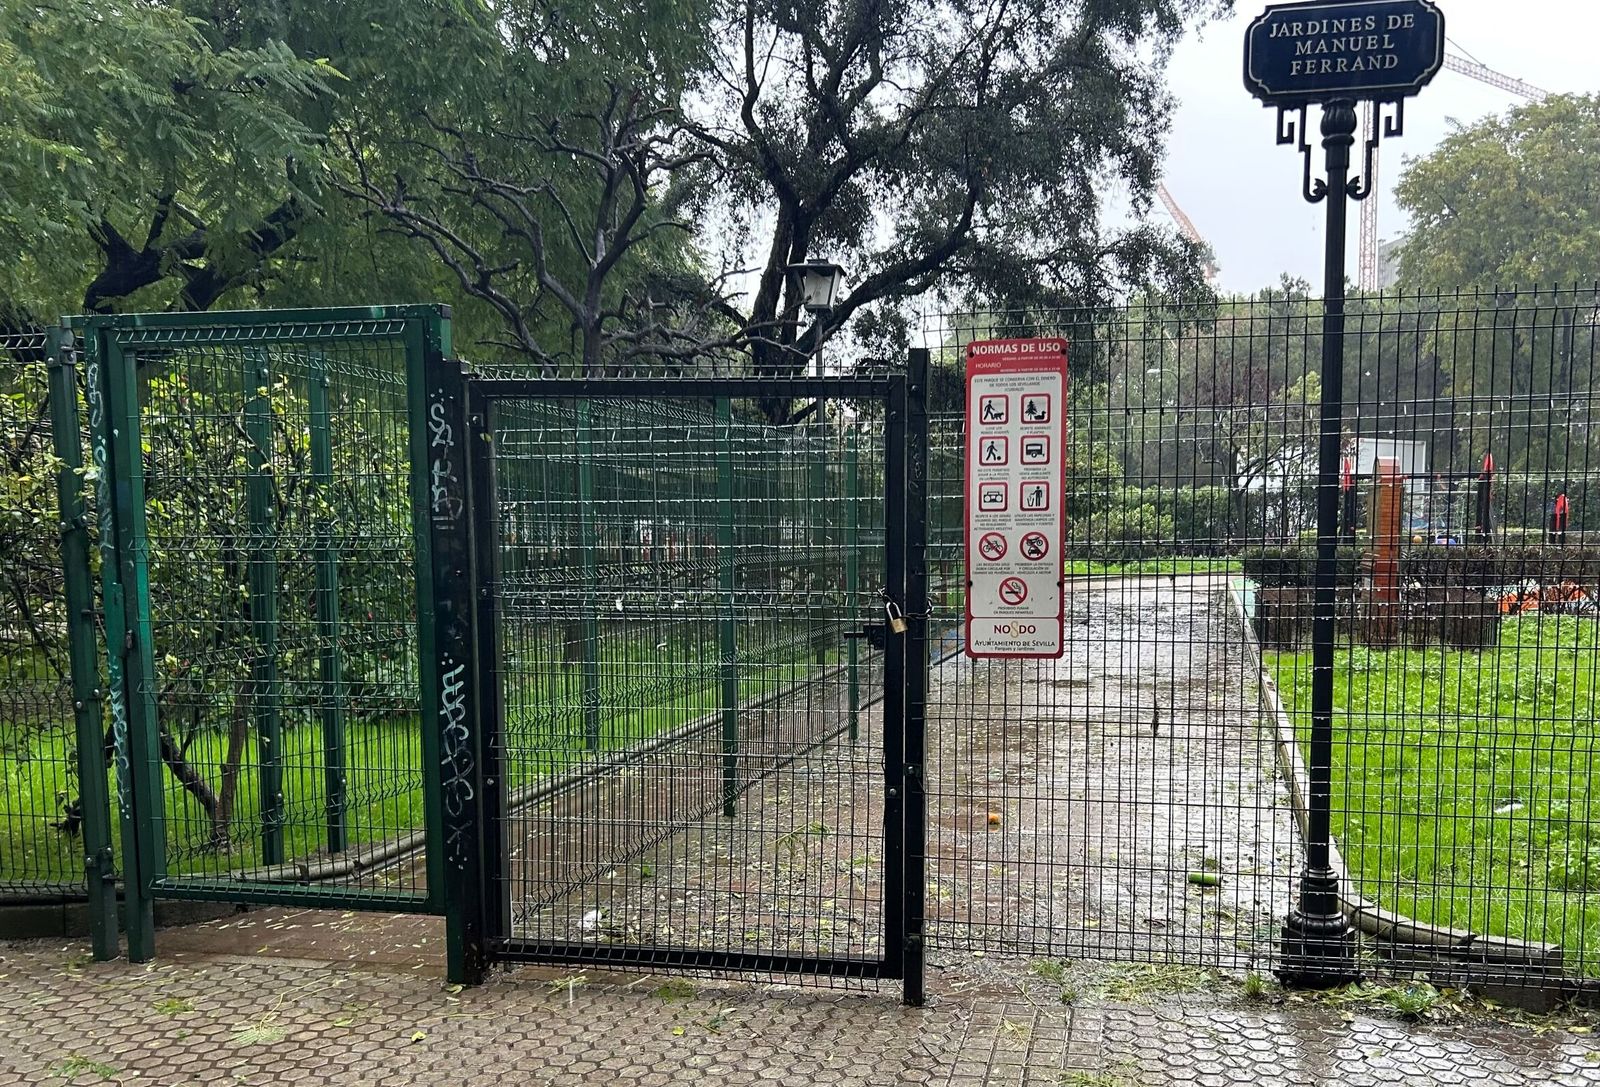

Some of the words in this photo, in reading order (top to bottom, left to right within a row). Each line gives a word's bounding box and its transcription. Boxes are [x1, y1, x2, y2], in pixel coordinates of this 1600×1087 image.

[1269, 15, 1376, 38] JARDINES
[1387, 13, 1415, 30] DE
[1295, 34, 1395, 56] MANUEL
[1289, 54, 1399, 76] FERRAND
[972, 344, 1018, 355] NORMAS
[1021, 343, 1035, 353] DE
[1038, 342, 1060, 352] USO
[975, 361, 1002, 369] HORARIO
